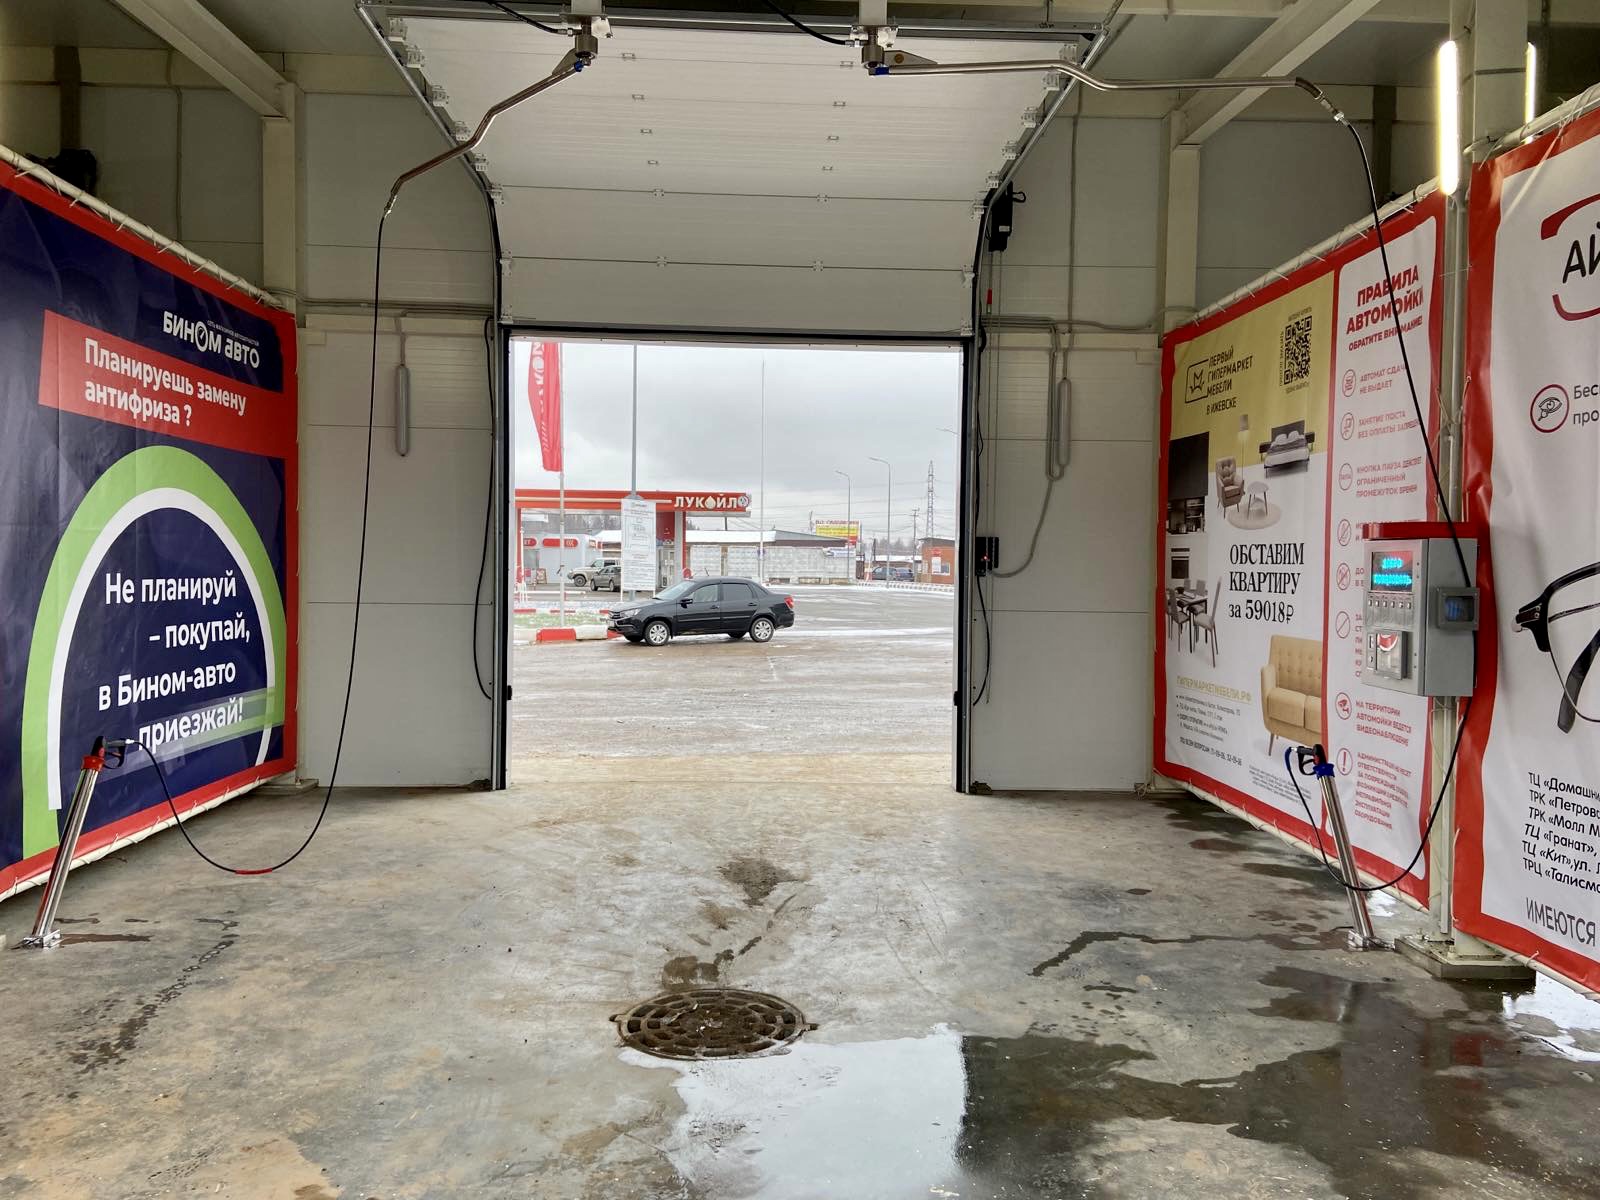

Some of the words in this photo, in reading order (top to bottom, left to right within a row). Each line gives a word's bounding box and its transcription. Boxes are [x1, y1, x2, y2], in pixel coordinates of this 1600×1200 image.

[1357, 264, 1419, 307] ПРАВИЛА
[163, 311, 222, 354] БИНОМ
[1348, 331, 1382, 352] ОБРАТИТЕ
[1208, 344, 1234, 368] ПЕРВЫЙ
[85, 337, 194, 397] Планируешь
[197, 381, 247, 416] замену
[1207, 355, 1253, 383] ГИПЕРМАРКЕТ
[1387, 362, 1406, 376] СДАЧ
[1206, 378, 1232, 397] МЕБЕЛИ
[1574, 384, 1600, 399] Бес
[85, 380, 181, 426] антифриза
[183, 404, 193, 427] ?
[1211, 396, 1237, 413] ИЖЕВСКЕ
[1229, 542, 1305, 565] ОБСТАВИМ
[105, 572, 135, 605] Не
[141, 570, 237, 606] планируй
[1229, 571, 1301, 595] КВАРТИРУ
[1229, 603, 1242, 618] за
[165, 612, 250, 650] покупай,
[98, 685, 111, 712] в
[117, 661, 237, 707] Бином-авто
[138, 697, 244, 754] приезжай!
[1528, 771, 1541, 789] ТЦ
[1529, 789, 1546, 806] ТРК
[1529, 806, 1546, 823] ТРК
[1548, 813, 1585, 834] «Молл
[1522, 840, 1537, 858] ТЦ
[1525, 823, 1541, 841] ТЦ
[1543, 830, 1597, 857] «Гранат»,
[1523, 857, 1543, 877] ТРЦ
[1526, 897, 1596, 947] ИМЕЮТСЯ
